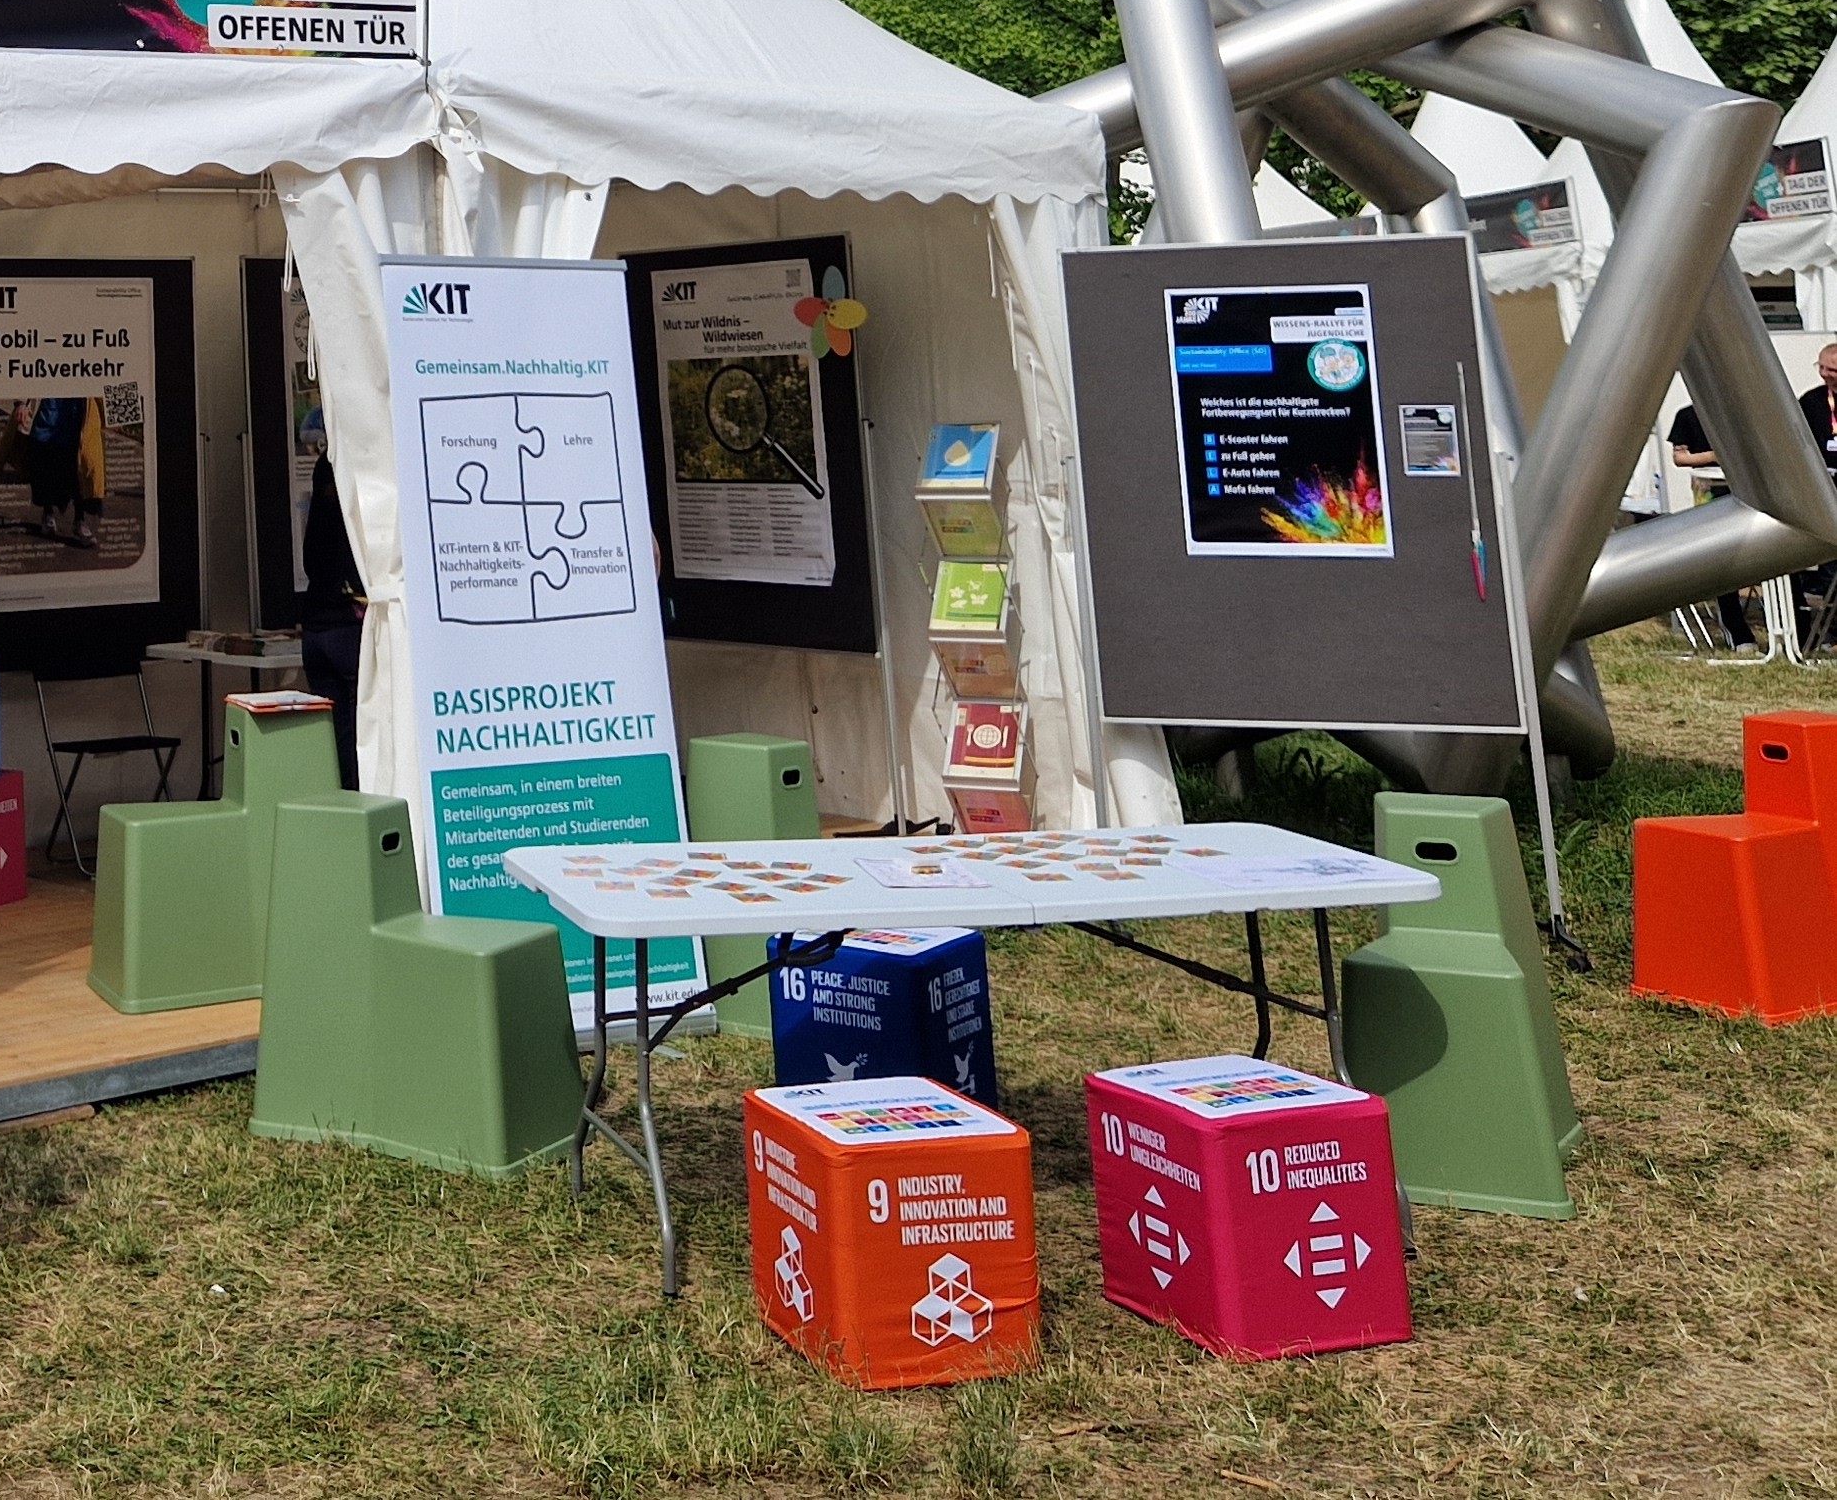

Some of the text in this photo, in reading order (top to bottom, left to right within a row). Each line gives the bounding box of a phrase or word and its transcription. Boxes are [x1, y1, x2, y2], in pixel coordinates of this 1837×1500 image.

[219, 15, 405, 45] OFFENEN TÜR
[1808, 176, 1825, 187] DER
[1770, 196, 1828, 214] OFFENEN TÜR
[420, 283, 470, 314] KIT
[664, 315, 740, 330] Mut zur Wildnis
[1272, 318, 1364, 328] WISSENS-RALLYE FÜR
[63, 333, 85, 347] zu
[93, 329, 130, 347] Fuß
[702, 331, 763, 343] Wildwiesen
[737, 343, 776, 353] biologische
[778, 341, 807, 350] Vielfalt
[1179, 348, 1227, 356] Sustainability
[9, 358, 124, 378] Fußverkehr
[415, 359, 610, 378] Gemeinsam.Nachhaltig.KIT
[1200, 397, 1319, 407] Welches ist die nachhaltigste
[1202, 407, 1351, 419] Fortbewegungsart für Kurzstrecken?
[442, 435, 497, 449] Forschung
[563, 434, 592, 446] Lehre
[1220, 434, 1288, 444] E-Scooter fahren
[1221, 451, 1276, 463] zu Fuß gehen
[1223, 468, 1250, 478] E-Auto
[1253, 468, 1280, 478] fahren
[1224, 484, 1275, 494] Mofa fahren
[439, 541, 523, 554] KIT-intern & KIT-
[571, 547, 623, 559] Transfer &
[440, 559, 525, 573] Nachhaltigkeits-
[571, 564, 626, 575] Innovation
[451, 578, 518, 592] performance
[434, 680, 615, 716] BASISPROJEKT
[437, 714, 655, 754] NACHHALTIGKEIT
[441, 774, 621, 800] Gemeinsam, in einem breiten
[443, 797, 594, 823] Beteiligungsprozess mit
[445, 824, 540, 845] Mitarbeitenden
[544, 822, 567, 836] und
[570, 816, 649, 834] Studierenden
[447, 855, 469, 869] des
[780, 967, 805, 1001] 16
[811, 970, 890, 996] PEACE, JUSTICE
[813, 989, 875, 1012] AND STRONG
[928, 977, 942, 1014] 16
[813, 1007, 882, 1031] INSTITUTIONS
[1101, 1112, 1124, 1157] 10
[753, 1130, 763, 1172] 9
[1284, 1141, 1340, 1165] REDUCED
[1246, 1149, 1280, 1195] 10
[1287, 1162, 1367, 1190] INEQUALITIES
[868, 1179, 889, 1223] 9
[900, 1196, 1006, 1221] INNOVATION AND
[901, 1220, 1014, 1246] INFRASTRUCTURE
